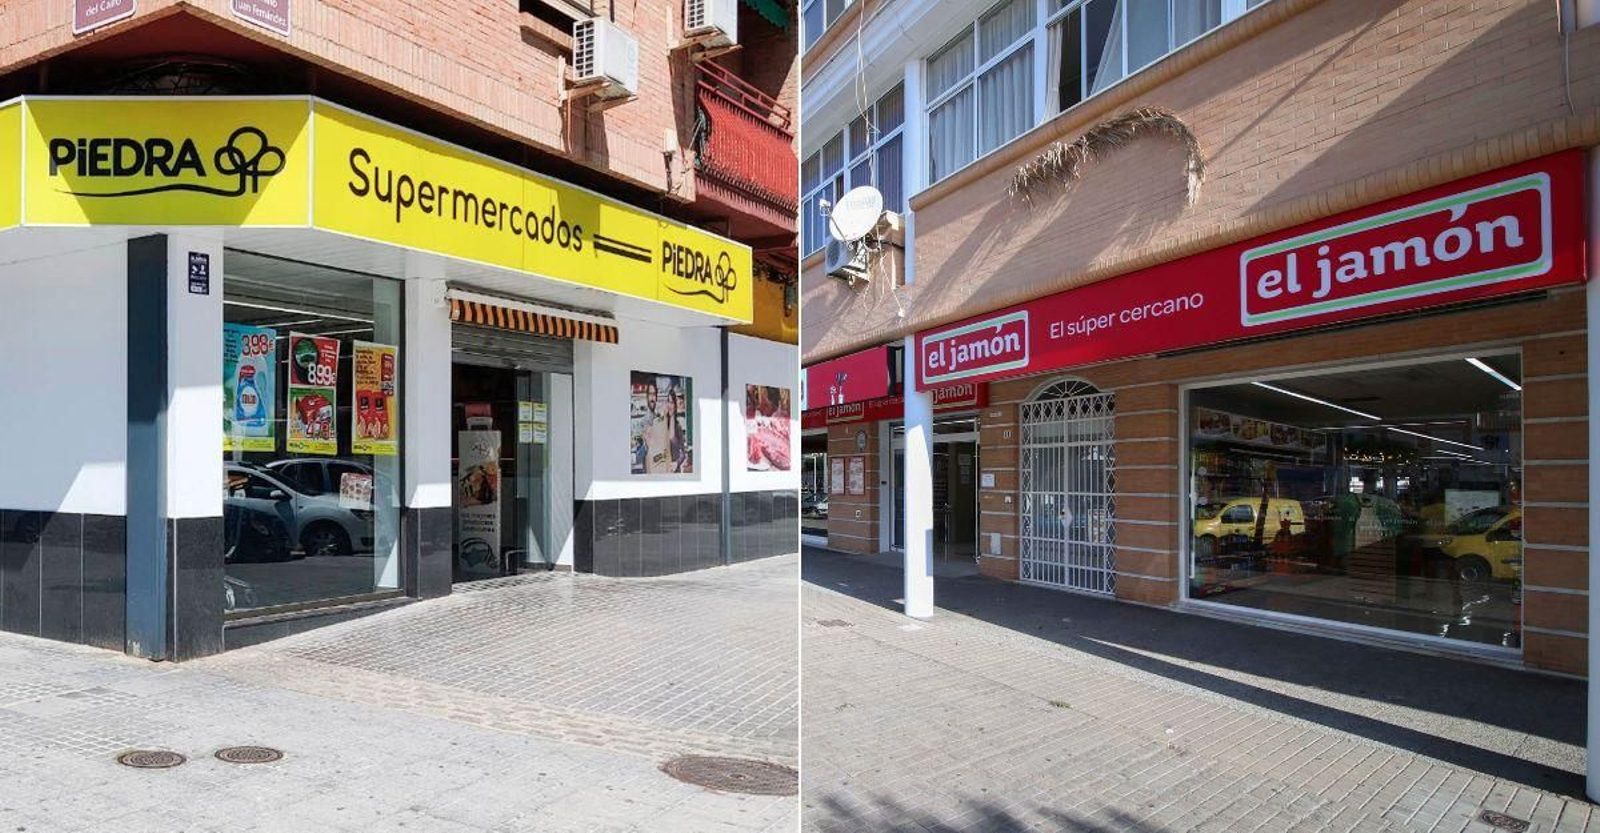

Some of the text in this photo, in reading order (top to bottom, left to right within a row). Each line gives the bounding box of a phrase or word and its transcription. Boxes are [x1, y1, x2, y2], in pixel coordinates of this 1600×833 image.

[348, 147, 583, 252] Supermercados
[1256, 203, 1524, 299] el jamón
[928, 324, 1021, 371] el jamón
[1049, 292, 1204, 339] El súper cercano
